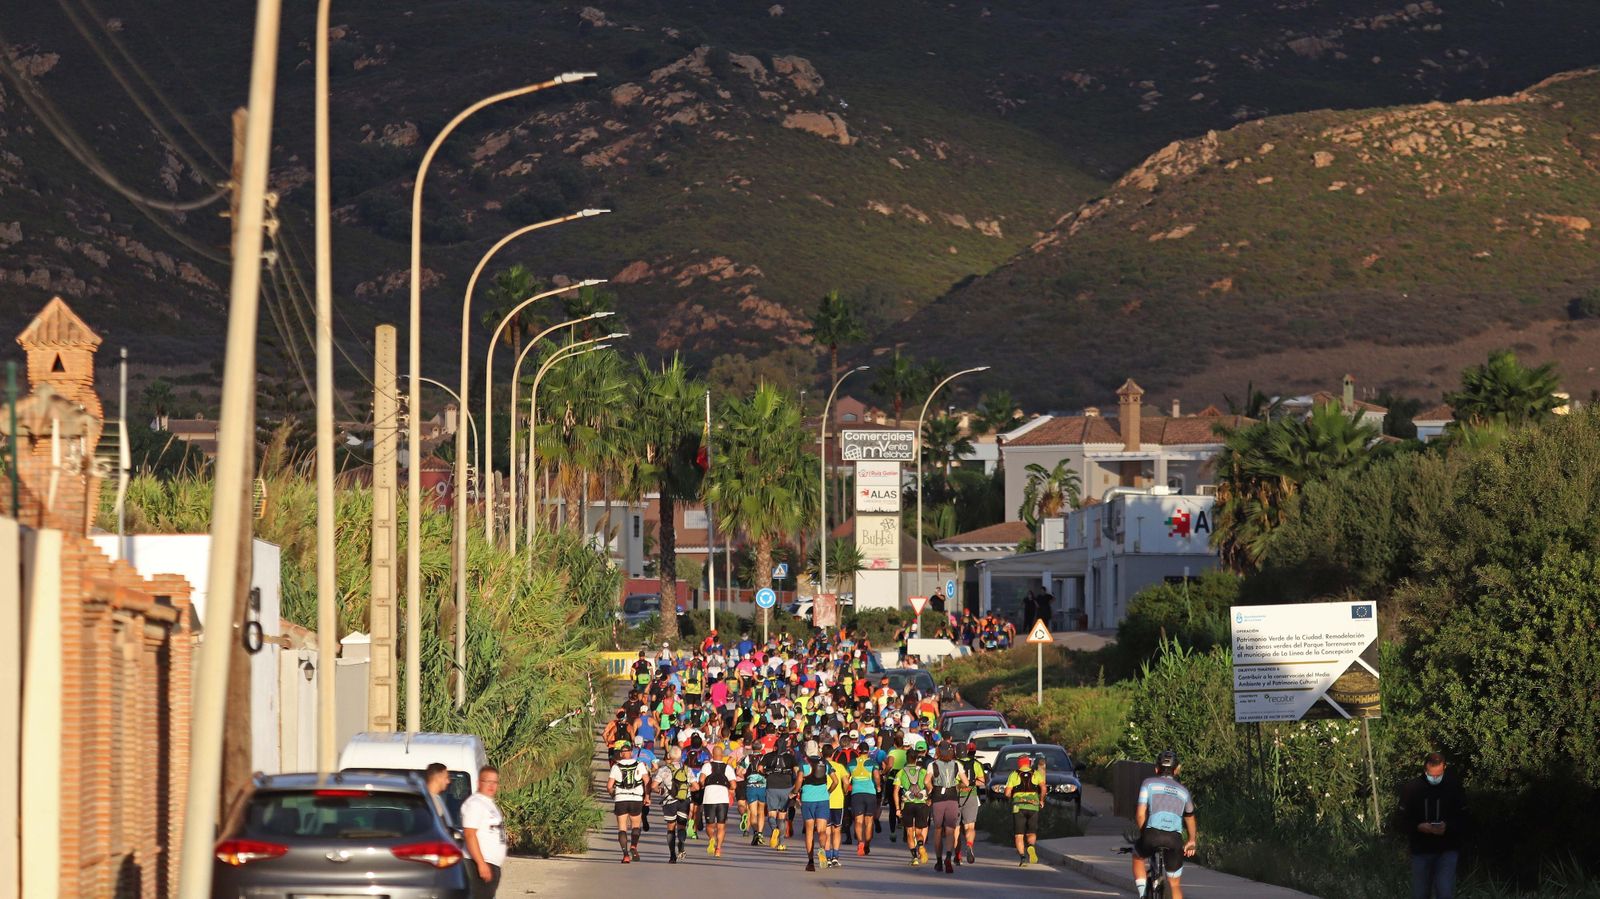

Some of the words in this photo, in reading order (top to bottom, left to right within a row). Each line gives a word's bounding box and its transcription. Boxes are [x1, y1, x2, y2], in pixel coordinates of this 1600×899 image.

[845, 432, 913, 441] Comerciales
[879, 441, 908, 452] Venta
[871, 490, 897, 499] ALAS
[1326, 632, 1365, 640] Remodelación
[1244, 651, 1271, 659] municipio
[1321, 648, 1354, 656] Concepción
